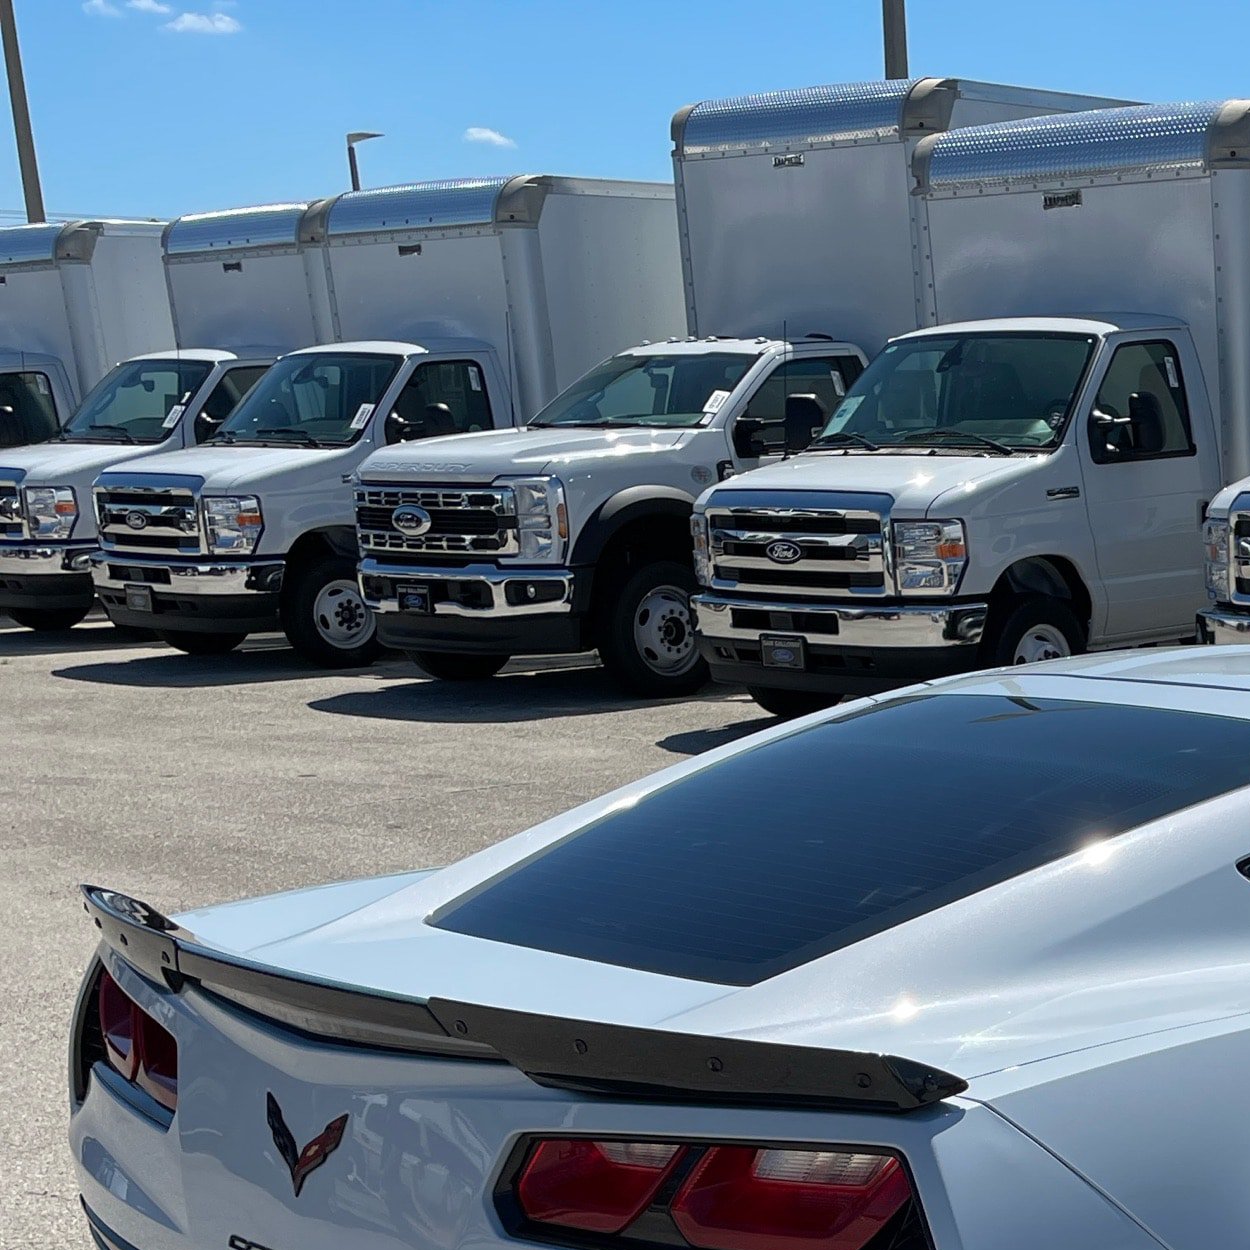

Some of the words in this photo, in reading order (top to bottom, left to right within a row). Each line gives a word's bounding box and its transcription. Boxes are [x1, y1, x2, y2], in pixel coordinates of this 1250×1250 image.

[369, 462, 418, 472] SUPER
[422, 463, 474, 472] DUTY
[772, 544, 794, 559] Ford
